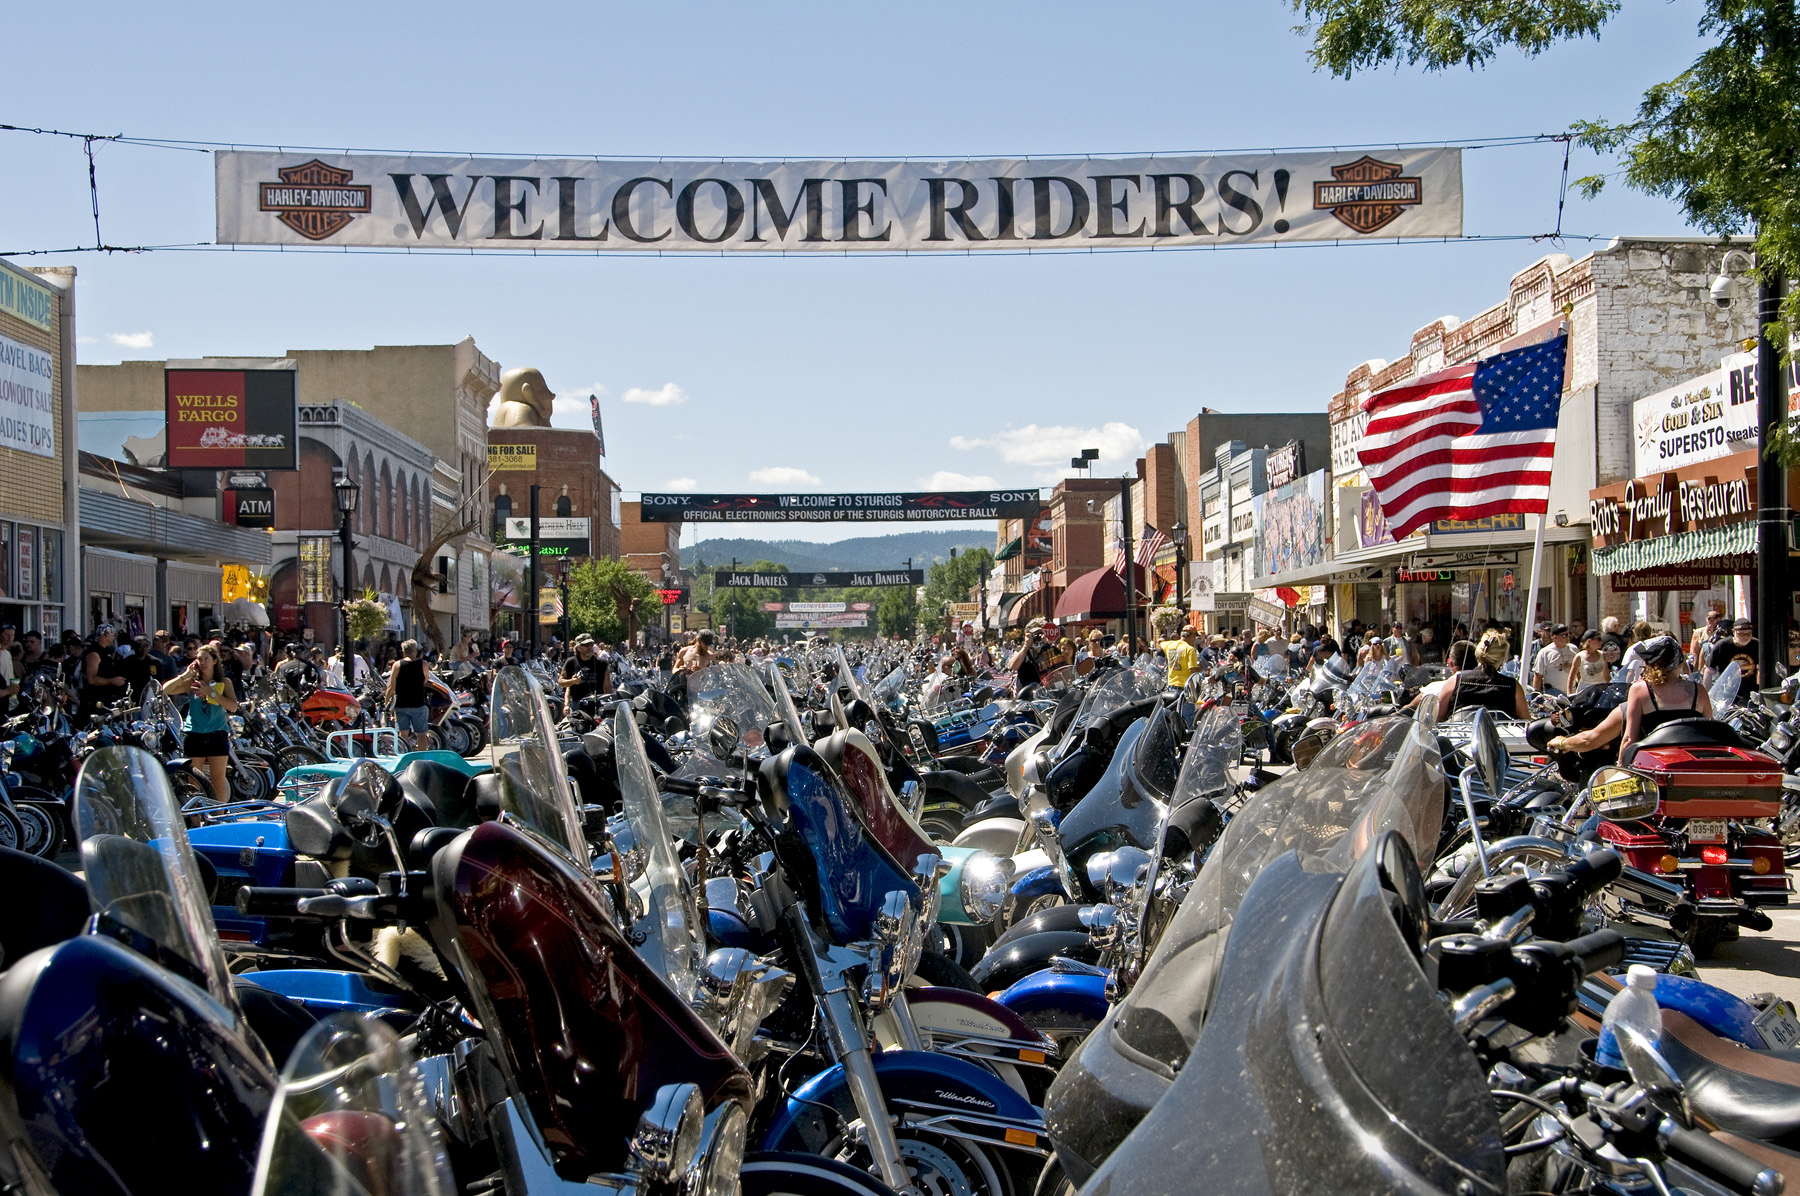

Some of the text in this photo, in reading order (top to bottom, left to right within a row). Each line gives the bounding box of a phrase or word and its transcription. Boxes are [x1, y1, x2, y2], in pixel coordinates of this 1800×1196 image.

[290, 169, 343, 184] MOTOR
[1343, 167, 1392, 181] MOTOR
[266, 187, 365, 209] HARLEY-DAVIDSON
[1319, 181, 1416, 203] HARLEY-DAVIDSON
[387, 168, 1291, 243] WELCOME RIDERS!
[290, 212, 346, 236] CYCLES
[1343, 204, 1395, 229] CYCLES
[0, 270, 51, 326] TM INSIDE
[0, 341, 52, 379] RAVEL BAGS
[0, 379, 52, 414] LOWOUT SALE
[176, 395, 237, 407] WELLS
[178, 410, 237, 422] FARGO
[1691, 406, 1701, 426] &
[1702, 401, 1723, 423] SILV
[0, 416, 51, 444] ADIES TOPS
[1726, 426, 1758, 443] steaks
[488, 446, 535, 455] NG FOR SALE
[1660, 426, 1724, 459] SUPERSTO
[1334, 448, 1355, 470] HARD
[239, 500, 271, 513] ATM
[643, 493, 1038, 507] SONY WELCOME TO STURGIS SONY
[1591, 474, 1752, 541] Bob's Family Restaurant
[684, 508, 998, 520] OFFICIAL ELECTRONICS SPONSOR OF THE STURGIS MOTORCYCLE RALLY.
[1691, 557, 1720, 568] Louis
[1723, 555, 1750, 571] Style
[728, 572, 911, 587] JACK DANIEL'S JACK DANIEL'S
[1615, 574, 1709, 588] Air Conditioned Seating
[956, 603, 979, 611] FIRESIDE
[1043, 628, 1059, 636] STOP
